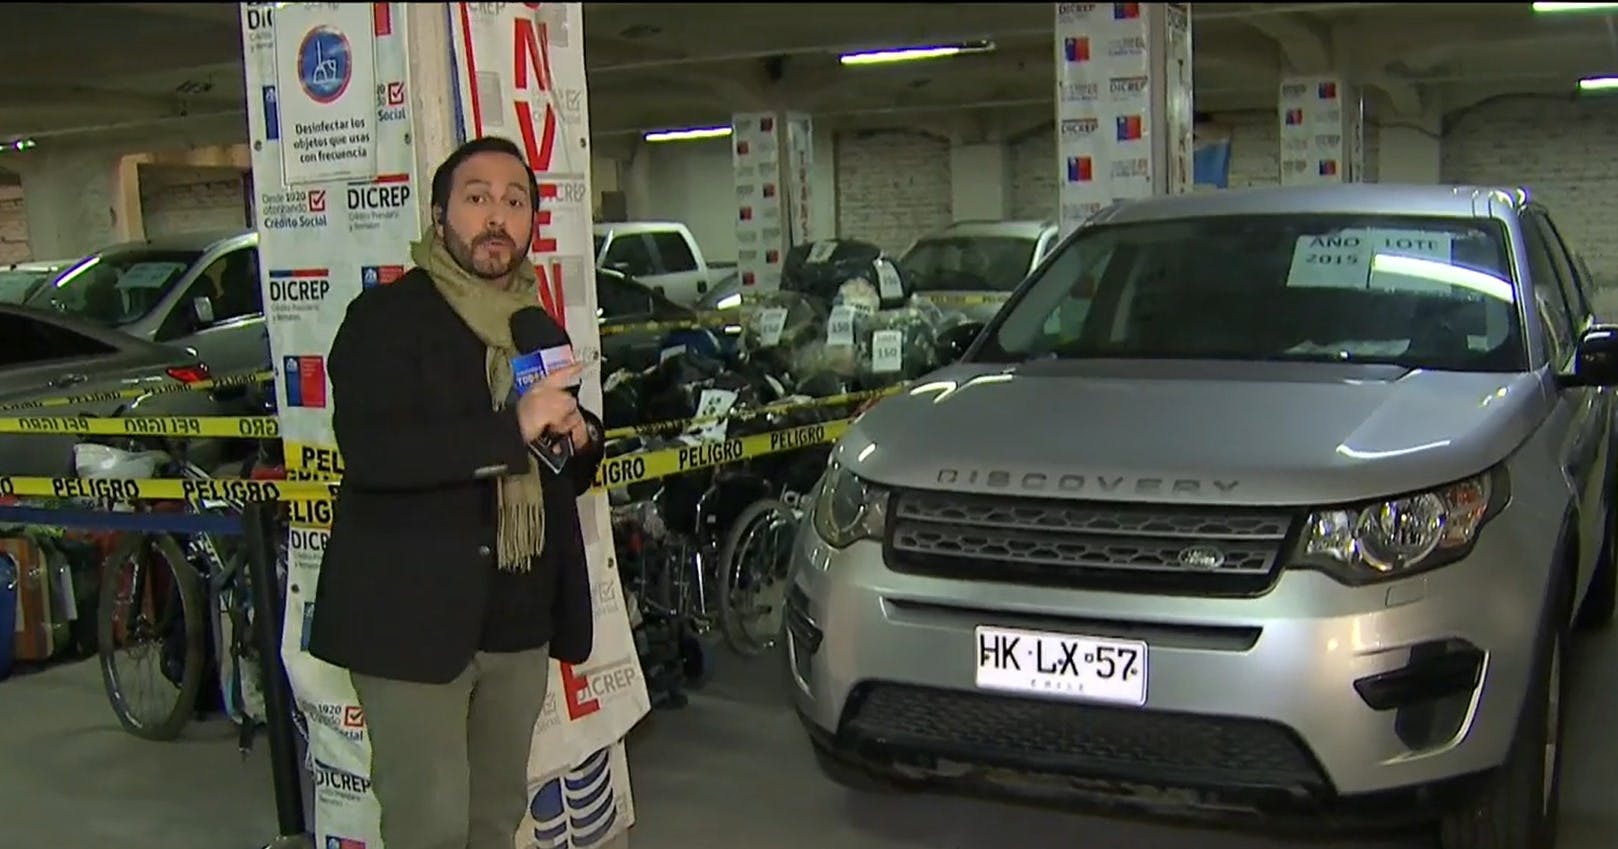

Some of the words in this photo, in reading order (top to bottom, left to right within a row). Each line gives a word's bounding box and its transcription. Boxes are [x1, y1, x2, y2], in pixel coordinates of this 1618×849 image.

[295, 121, 349, 135] Desinfectar
[350, 117, 366, 129] los
[293, 137, 328, 151] objetos
[329, 136, 347, 148] que
[349, 133, 370, 144] usas
[300, 153, 318, 164] con
[319, 147, 368, 161] frecuencia
[347, 185, 410, 210] DICREP
[299, 214, 328, 229] Social
[1305, 253, 1358, 265] 2015
[270, 280, 330, 301] DICREP
[593, 457, 646, 487] LIGRO
[678, 440, 744, 470] PELIGRO
[771, 426, 825, 451] PELIGRO
[52, 478, 140, 499] PELIGRO
[182, 480, 280, 502] PELIGRO
[937, 469, 1239, 493] DISCOVERY
